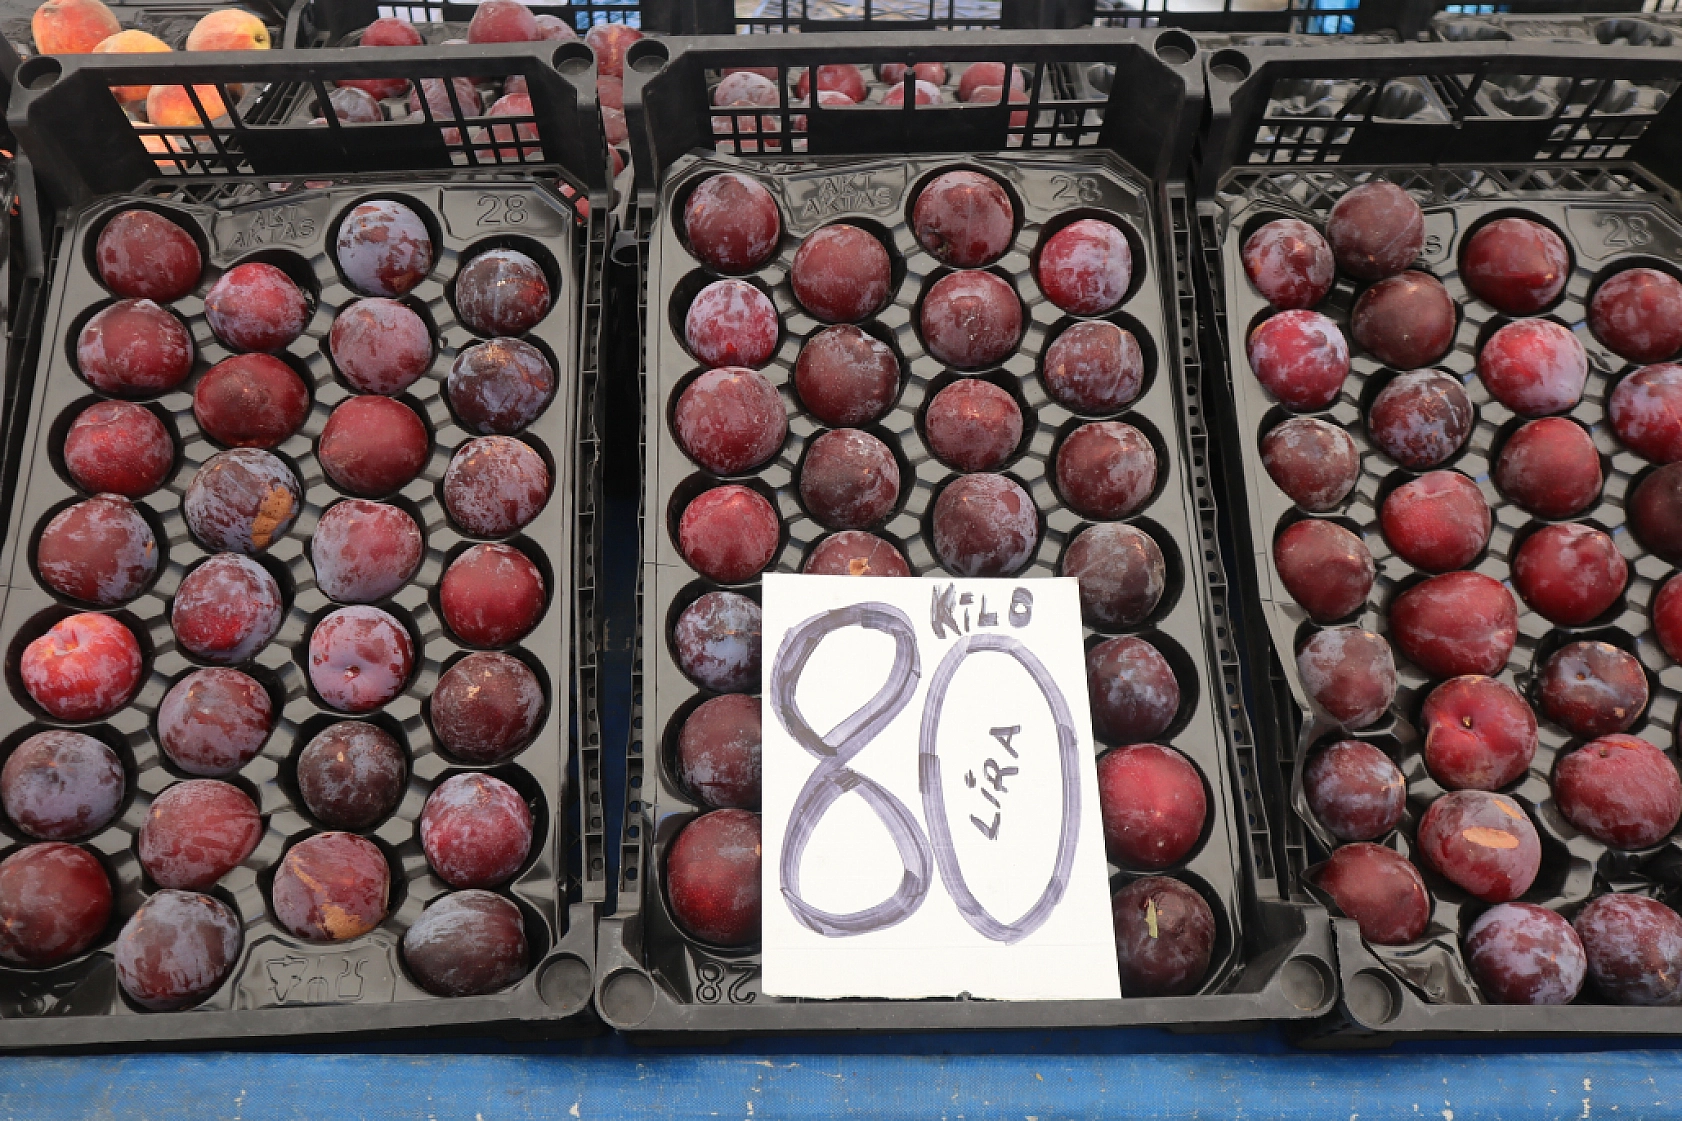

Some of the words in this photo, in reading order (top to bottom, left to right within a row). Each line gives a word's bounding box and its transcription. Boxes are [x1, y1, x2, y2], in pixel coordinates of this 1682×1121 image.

[1050, 174, 1104, 204] 28
[476, 194, 530, 227] 28
[1602, 214, 1655, 247] 28
[769, 600, 1083, 946] 80
[696, 961, 758, 1004] 28
